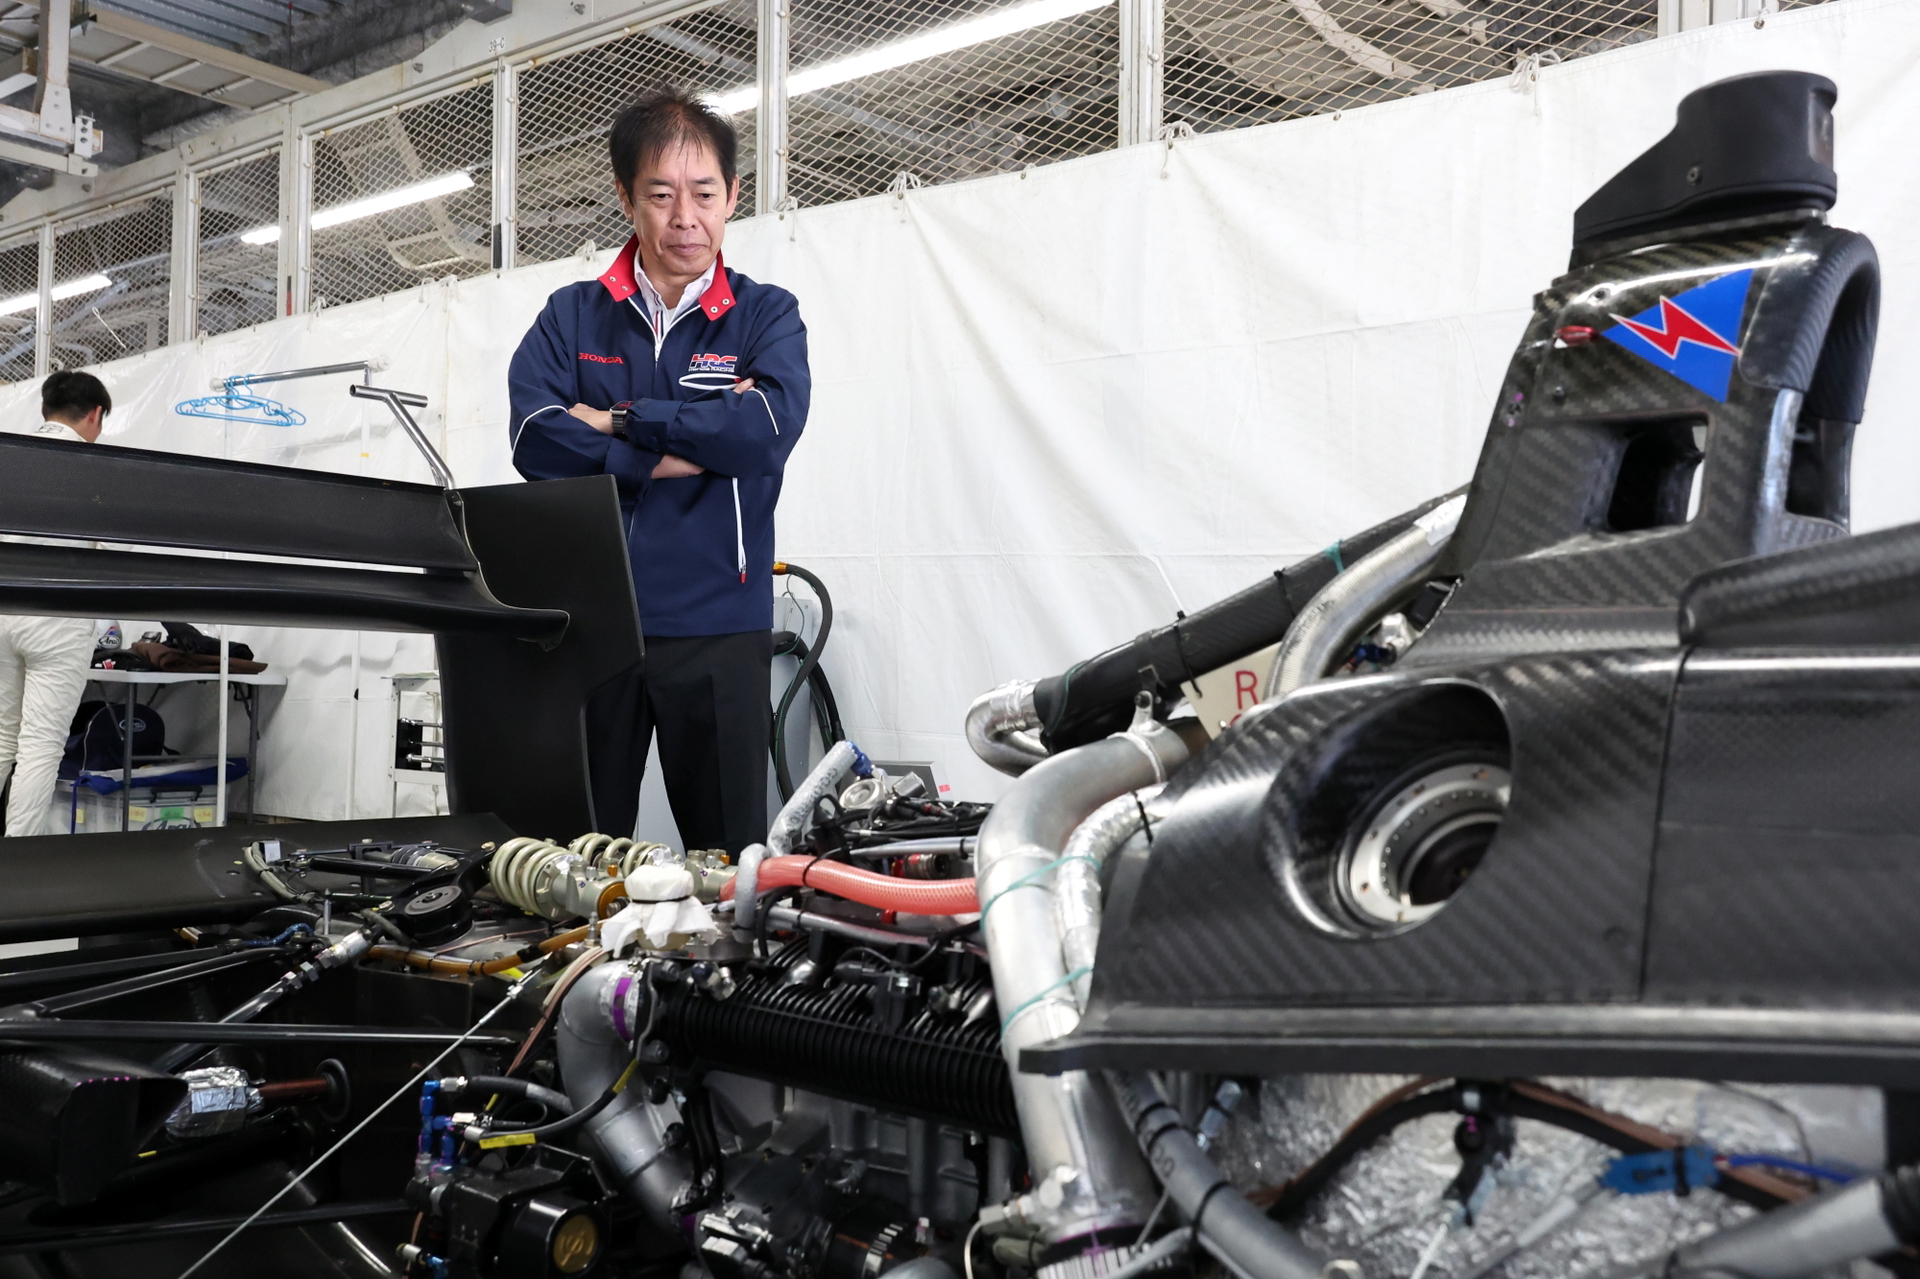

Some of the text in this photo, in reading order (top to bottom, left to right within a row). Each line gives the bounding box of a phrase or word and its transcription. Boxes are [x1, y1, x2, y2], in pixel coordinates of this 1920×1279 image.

[489, 36, 505, 52] 39-C
[578, 352, 625, 365] HONDA
[690, 353, 738, 368] HRC
[1235, 670, 1259, 710] R
